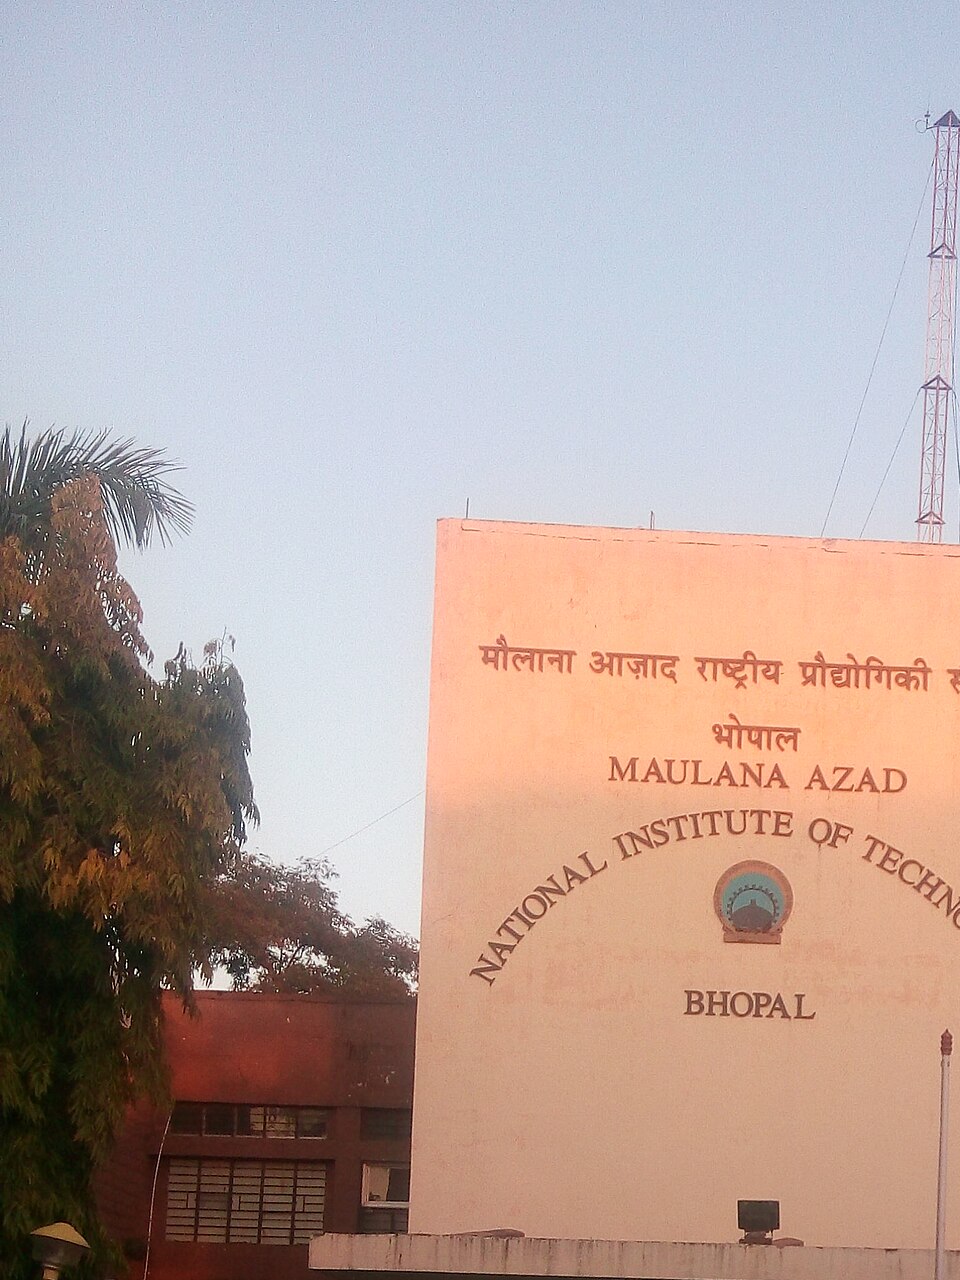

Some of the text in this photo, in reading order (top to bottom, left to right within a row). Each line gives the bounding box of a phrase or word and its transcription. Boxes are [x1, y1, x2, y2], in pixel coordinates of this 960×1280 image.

[479, 634, 577, 674] मौलाना
[589, 651, 680, 684] आज़ाद
[694, 650, 783, 689] राष्ट्रीय
[798, 651, 932, 691] प्रौद्योगिकी
[712, 713, 801, 752] भोपाल
[608, 756, 908, 794] MAULANA AZAD
[469, 851, 607, 987] NATIONAL
[612, 810, 793, 860] INSTITUTE
[809, 818, 854, 851] OF
[684, 990, 816, 1020] BHOPAL
